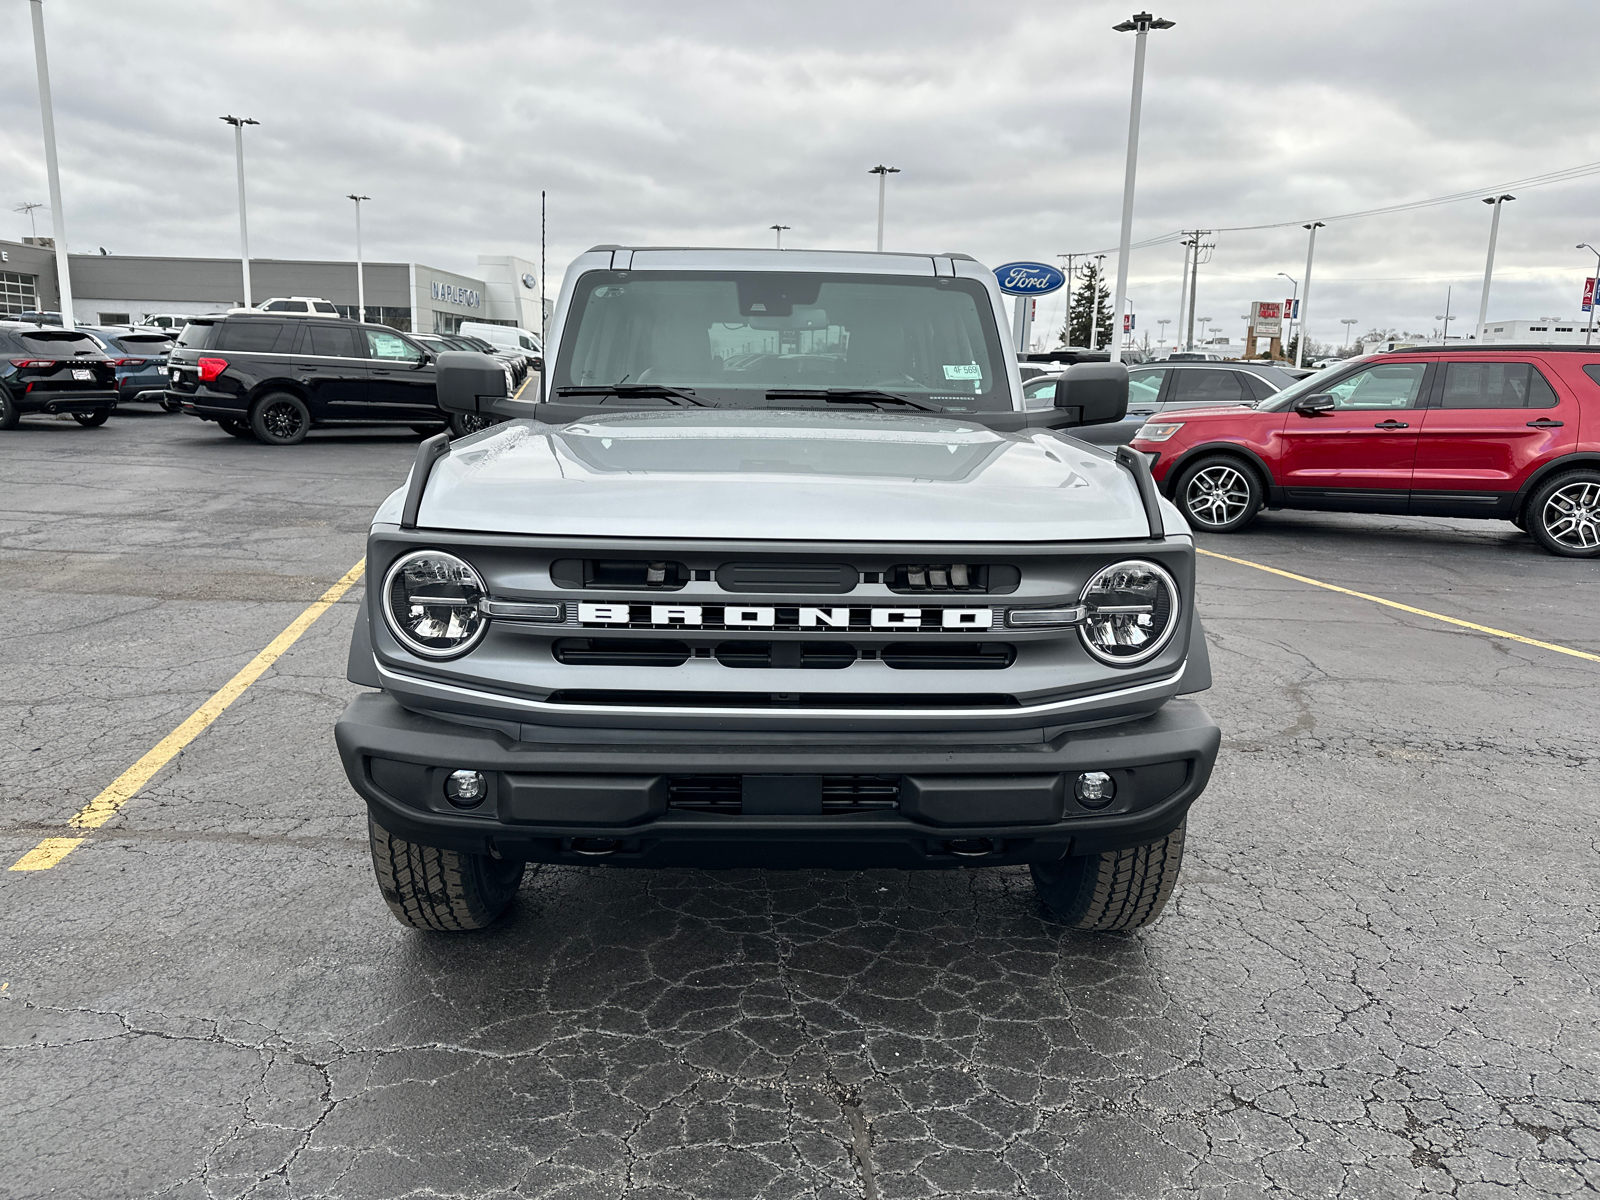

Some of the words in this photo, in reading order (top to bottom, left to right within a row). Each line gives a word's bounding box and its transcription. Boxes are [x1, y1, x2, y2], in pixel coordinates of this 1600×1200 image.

[1004, 267, 1051, 288] Ford
[431, 281, 480, 308] NAPLETON
[963, 366, 978, 374] 569
[578, 603, 993, 628] BRONCO
